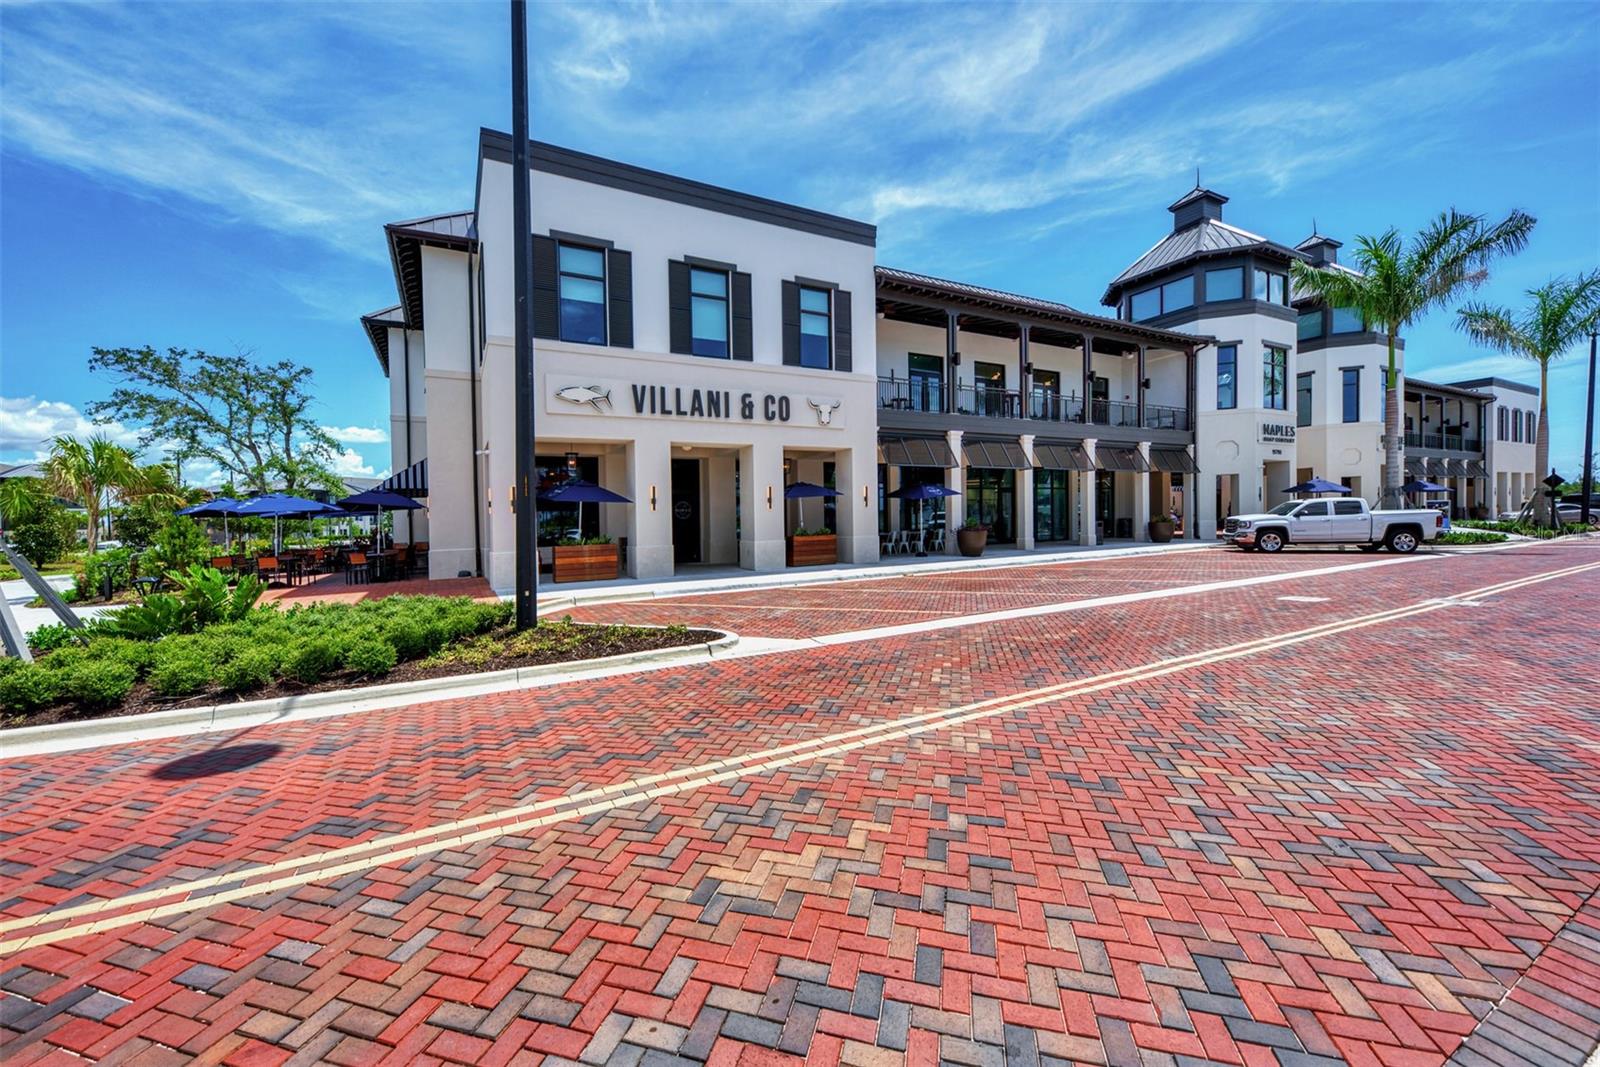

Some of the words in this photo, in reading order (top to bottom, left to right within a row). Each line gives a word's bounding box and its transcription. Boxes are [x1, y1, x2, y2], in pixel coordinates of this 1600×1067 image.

[631, 384, 731, 418] VILLANI
[741, 392, 755, 420] &
[763, 394, 791, 422] CO
[1263, 423, 1296, 437] NAPLES
